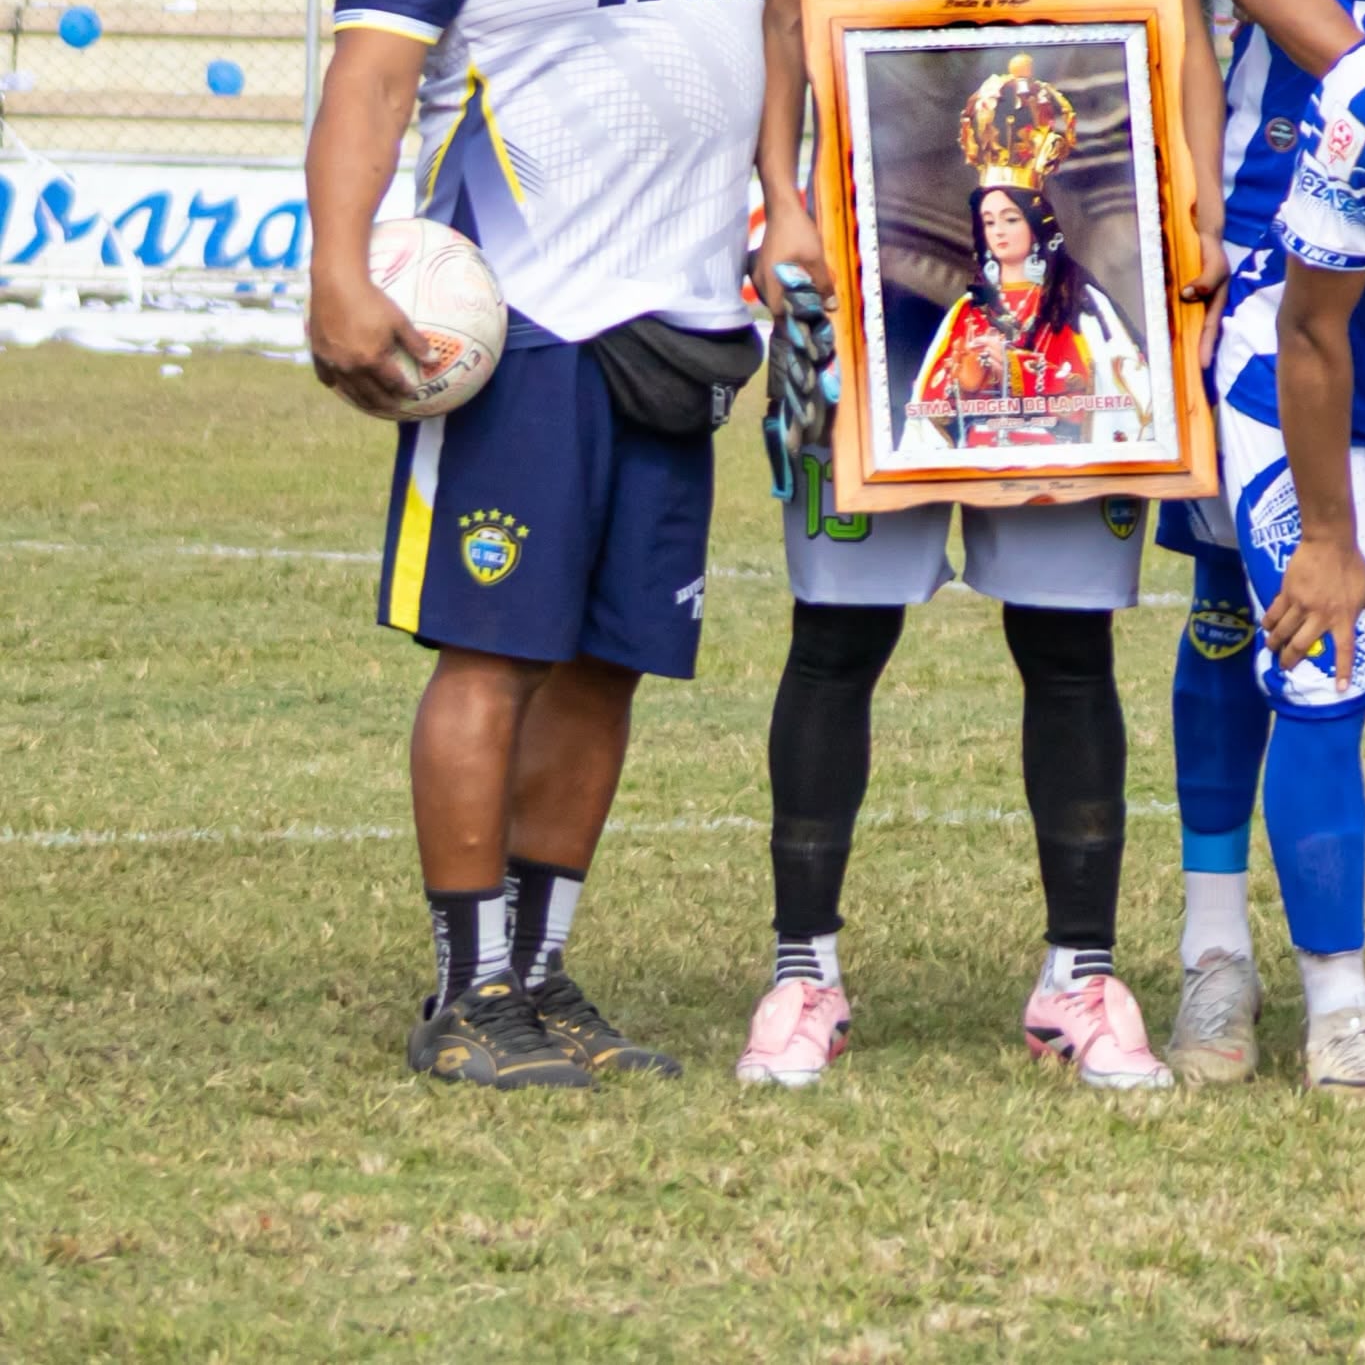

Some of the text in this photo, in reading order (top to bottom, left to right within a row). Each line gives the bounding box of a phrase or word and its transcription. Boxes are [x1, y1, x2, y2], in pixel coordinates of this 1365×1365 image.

[961, 397, 1020, 415] VIRGEN
[1024, 396, 1046, 413] DE
[1050, 396, 1072, 412] LA
[1074, 394, 1135, 411] PUERTA
